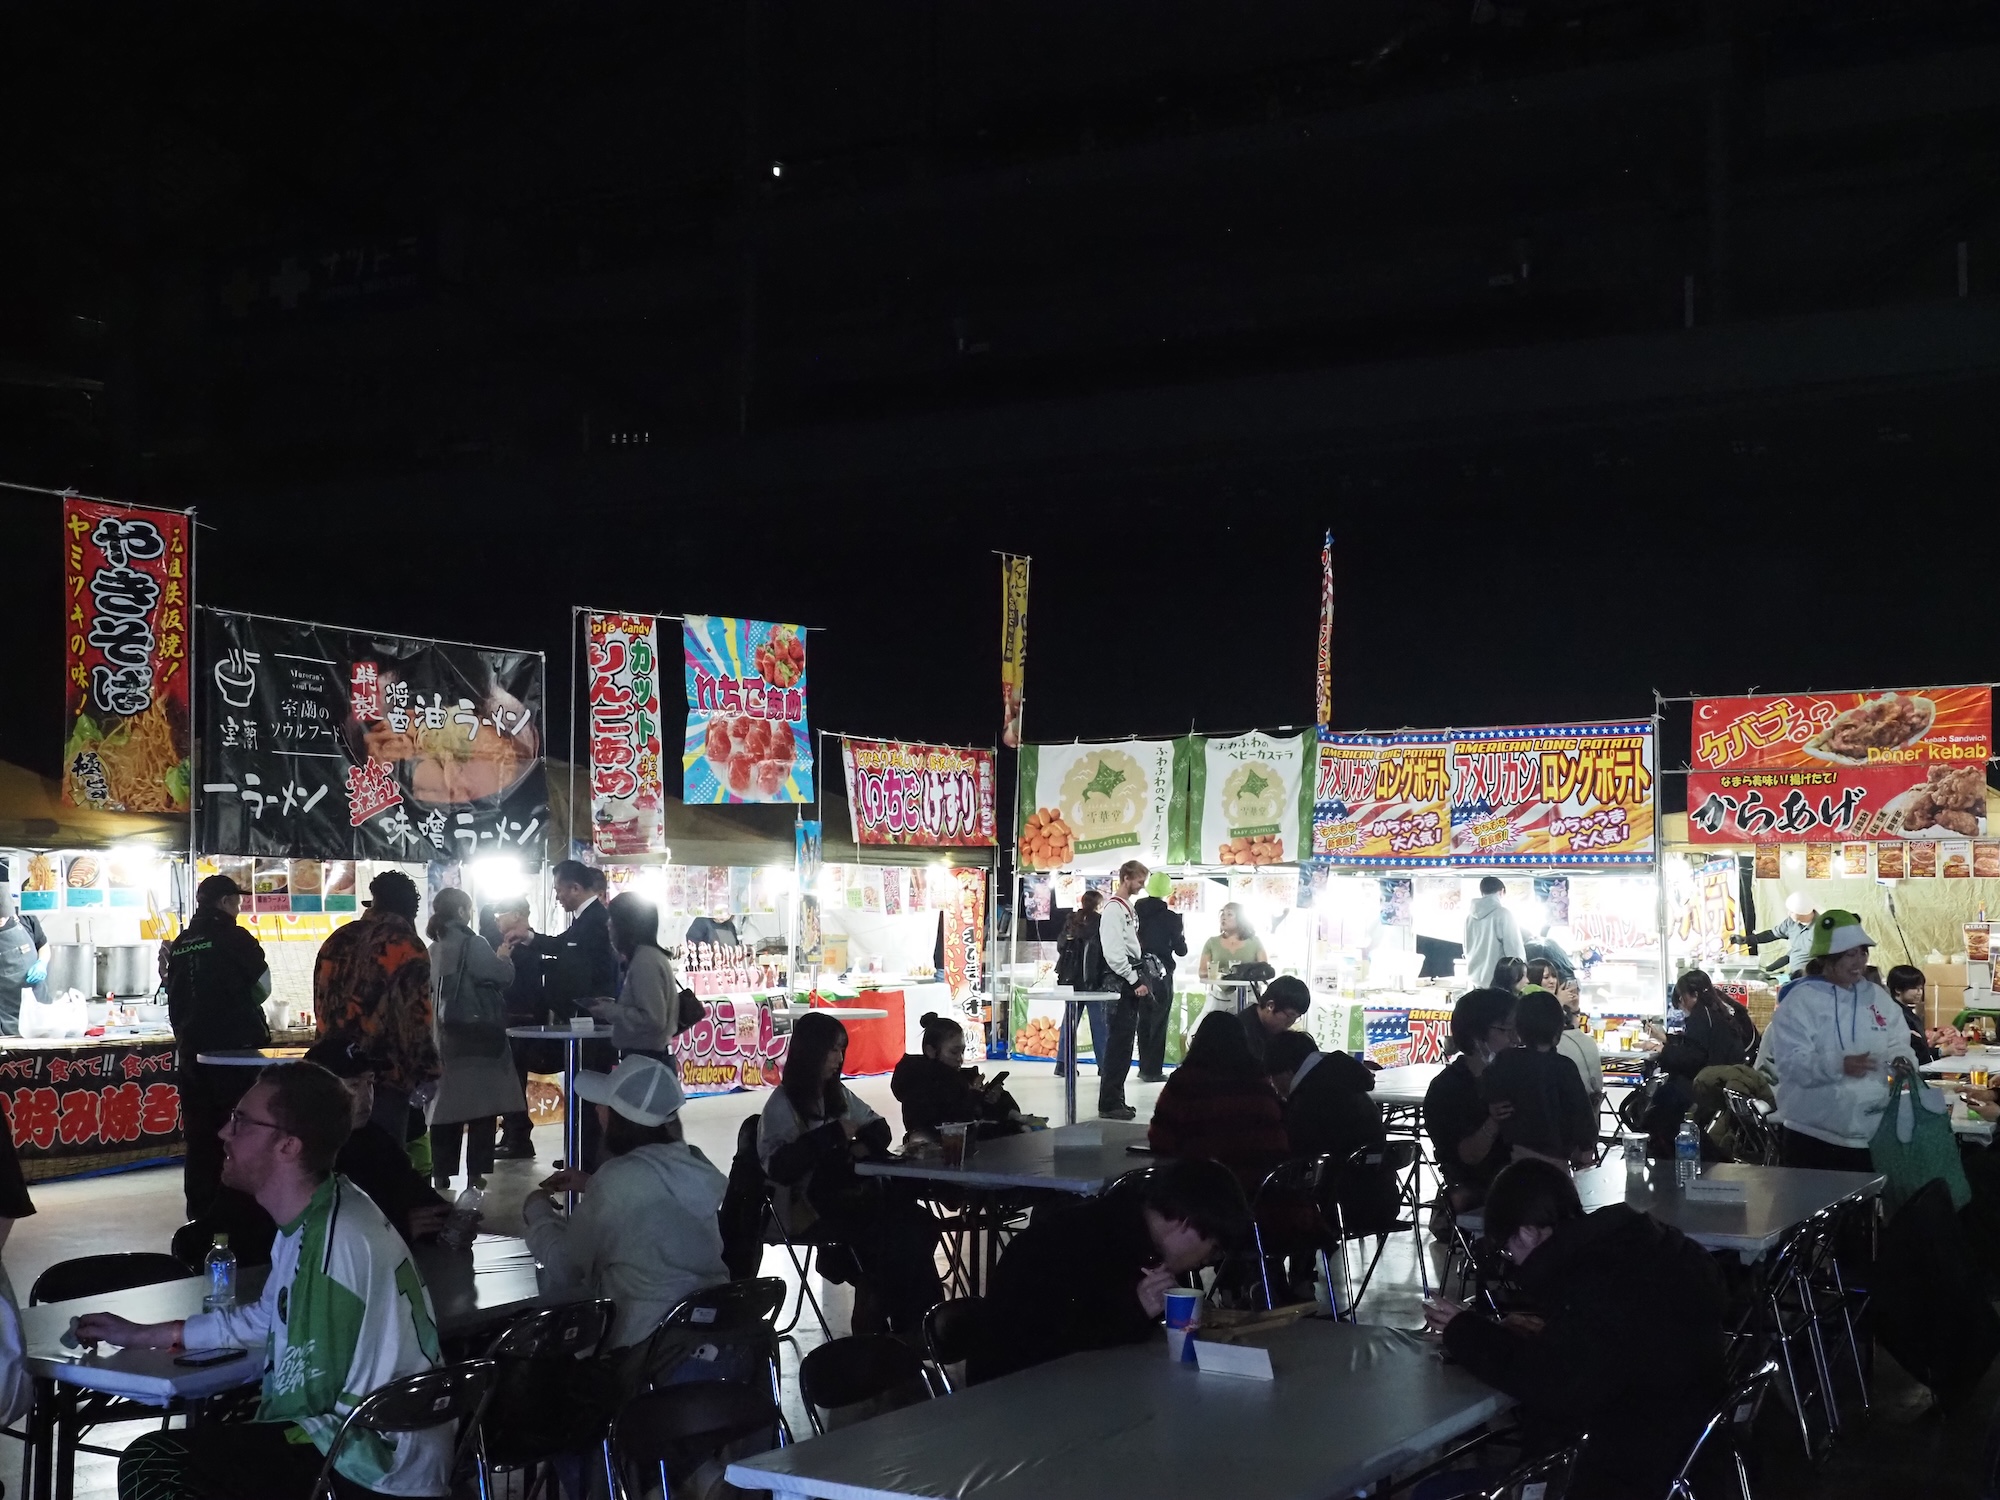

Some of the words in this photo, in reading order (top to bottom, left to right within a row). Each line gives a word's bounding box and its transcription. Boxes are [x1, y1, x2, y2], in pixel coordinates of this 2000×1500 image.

[66, 514, 91, 715] ヤミツキの味!
[88, 518, 166, 715] やきそば
[621, 621, 651, 635] Candy
[308, 683, 323, 693] food
[350, 664, 384, 721] 特製
[630, 639, 654, 748] カット
[695, 672, 804, 722] いちごあめ
[281, 699, 330, 720] 室蘭の
[385, 681, 532, 741] 醤油ラーメン
[590, 641, 637, 799] りんごあめ
[220, 715, 258, 750] 室蘭
[271, 722, 341, 743] ソウルフード
[1215, 737, 1269, 751] ふわふわの
[1454, 740, 1534, 754] AMERICAN
[1534, 739, 1577, 752] LONG
[1579, 737, 1644, 751] POTATO
[1696, 697, 1837, 769] ケバブる?
[1924, 735, 1947, 744] kebab
[1949, 733, 1988, 743] Sandwich
[1228, 750, 1294, 760] ベビーカステラ
[1321, 747, 1375, 759] AMERICAN
[1376, 749, 1401, 760] LONG
[1402, 748, 1446, 758] POTATO
[1866, 746, 1923, 763] Döner
[1928, 742, 1988, 760] kebab
[859, 767, 977, 837] いちごけずり
[1151, 747, 1168, 859] ふわふわのベビーカステラ
[1691, 786, 1867, 836] からあげ
[379, 805, 540, 857] 味噌ラーメン
[1319, 822, 1358, 838] もちもち
[1372, 811, 1440, 837] めちゃうま
[1471, 817, 1509, 836] もちもち
[1549, 807, 1627, 837] めちゃうま
[1078, 841, 1096, 851] BABY
[1098, 836, 1133, 848] CASTELLA
[1390, 828, 1443, 852] 大人気!
[1569, 824, 1631, 851] 大人気!
[172, 941, 212, 957] ALLIANCE
[47, 1053, 116, 1084] 食べて!!
